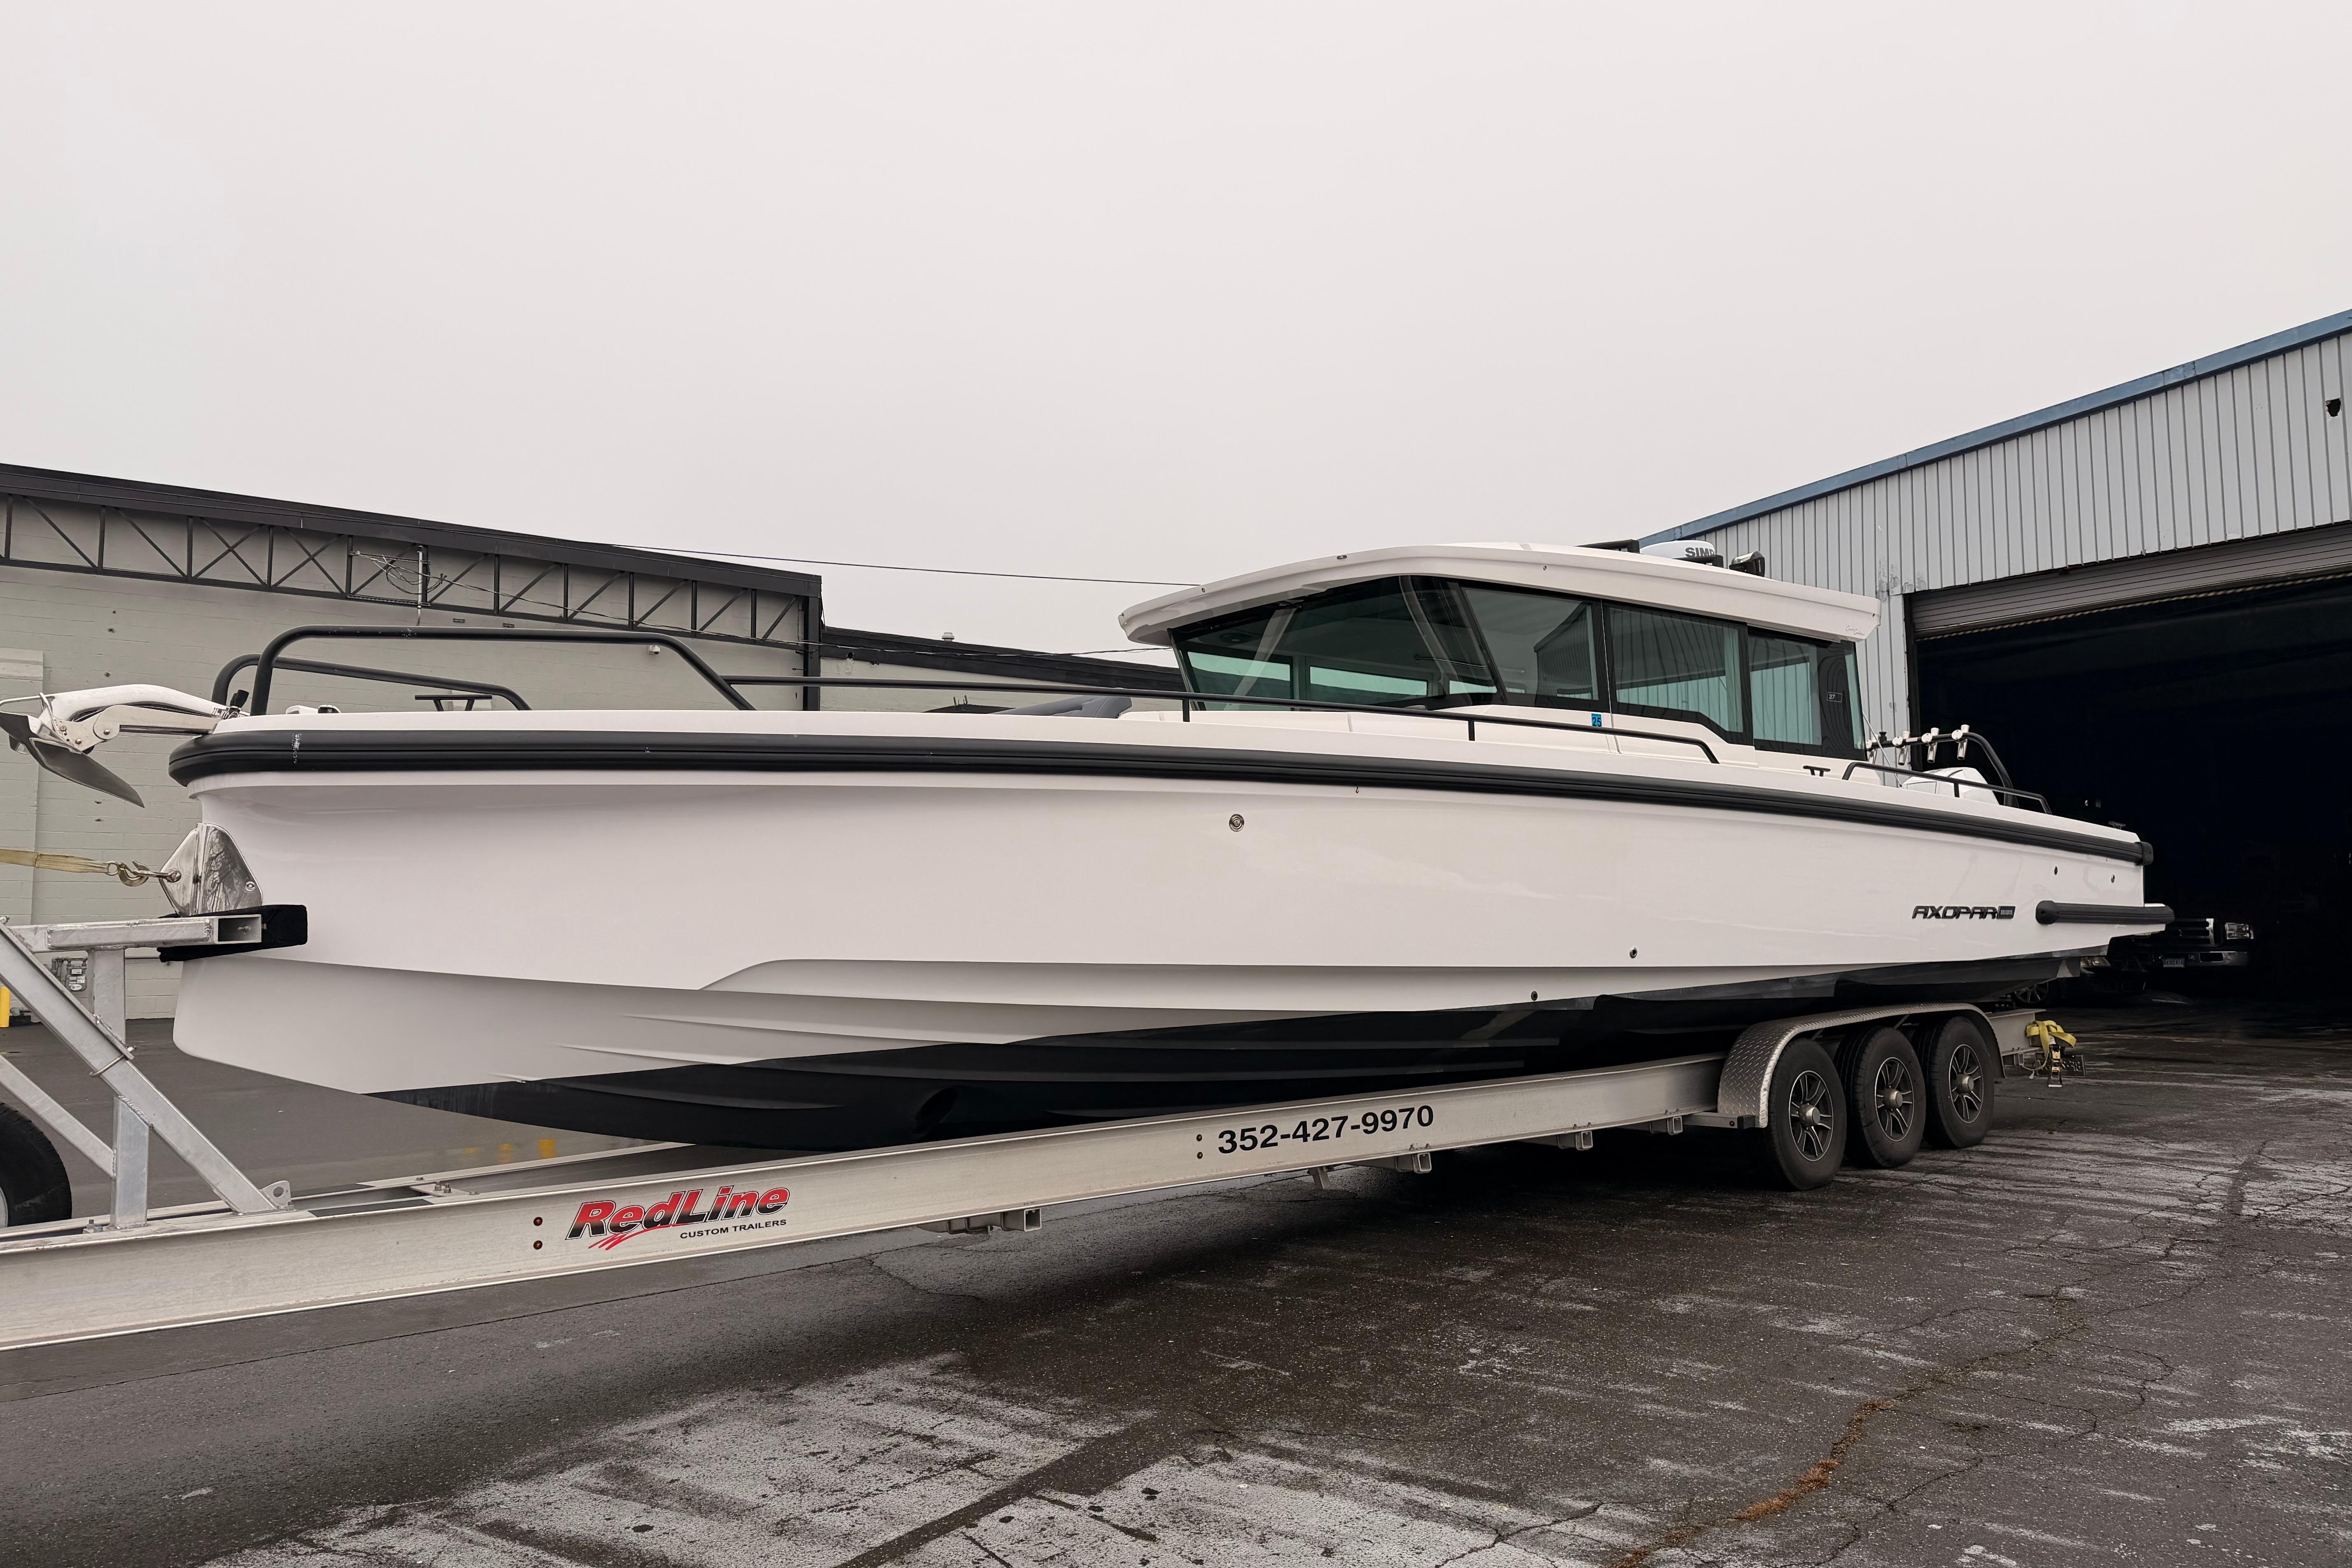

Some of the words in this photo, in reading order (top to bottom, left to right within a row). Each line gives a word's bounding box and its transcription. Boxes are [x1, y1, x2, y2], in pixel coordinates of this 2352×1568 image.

[1592, 717, 1602, 727] 25
[1911, 906, 1998, 919] AXOPAR
[1218, 1105, 1434, 1154] 352-427-9970
[565, 1185, 790, 1240] RedLine
[679, 1227, 729, 1239] CUSTOM
[732, 1219, 787, 1232] TRAILERS
